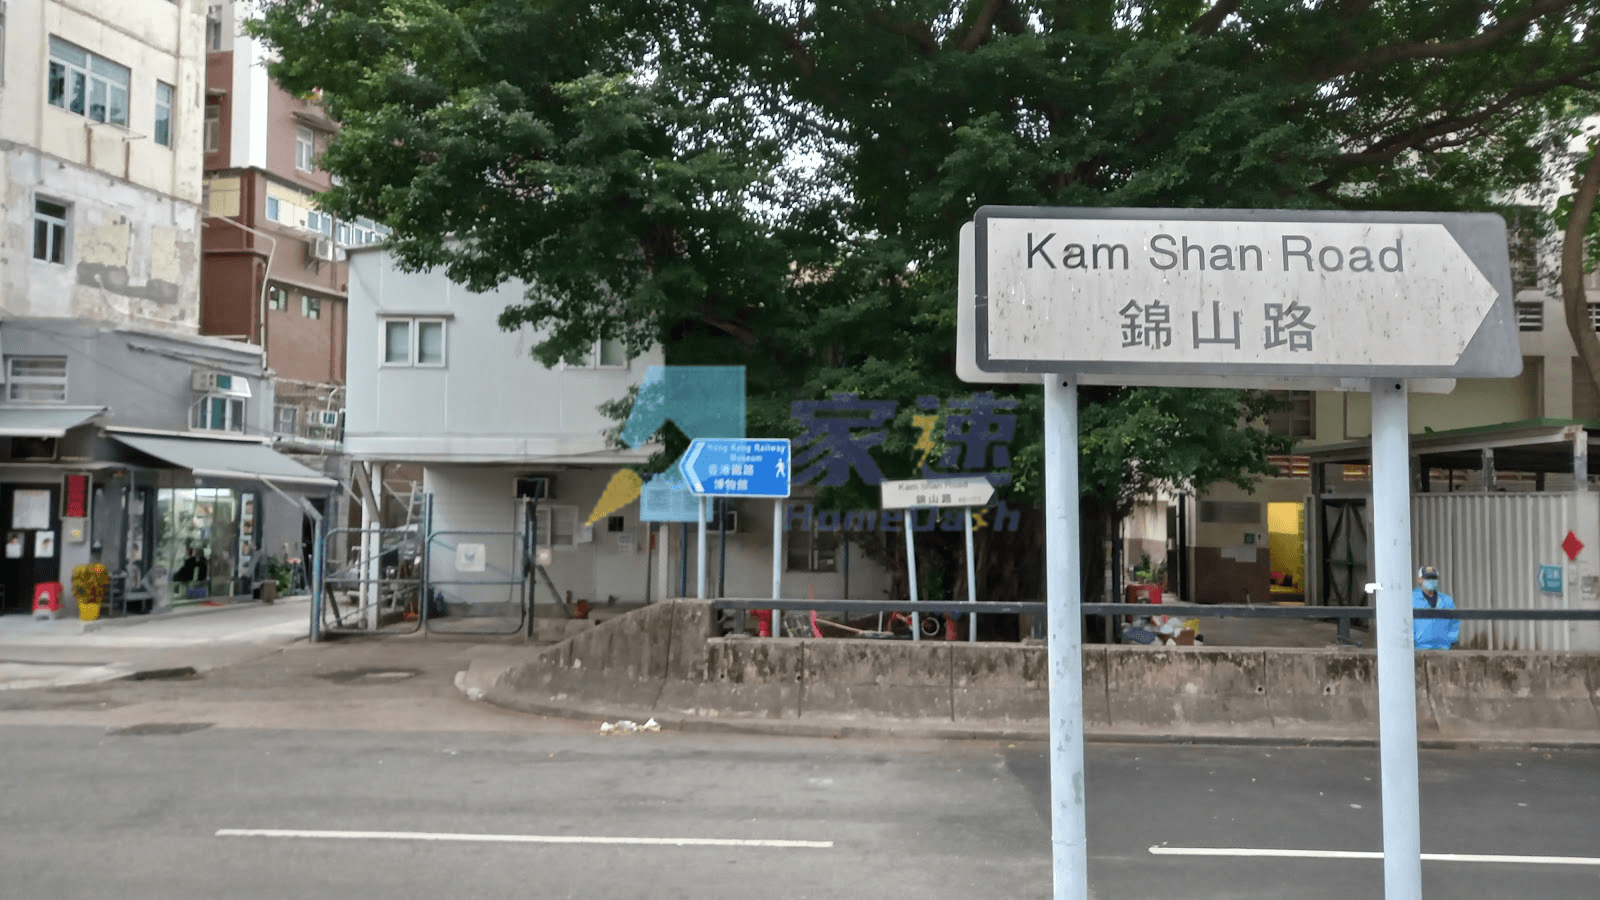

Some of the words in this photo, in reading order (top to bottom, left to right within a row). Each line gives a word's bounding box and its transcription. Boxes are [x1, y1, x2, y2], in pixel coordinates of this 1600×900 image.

[1026, 231, 1129, 271] Kam
[1148, 233, 1264, 272] Shan
[1280, 234, 1404, 274] Road
[1118, 299, 1317, 352] 錦山路
[754, 443, 786, 455] Railway
